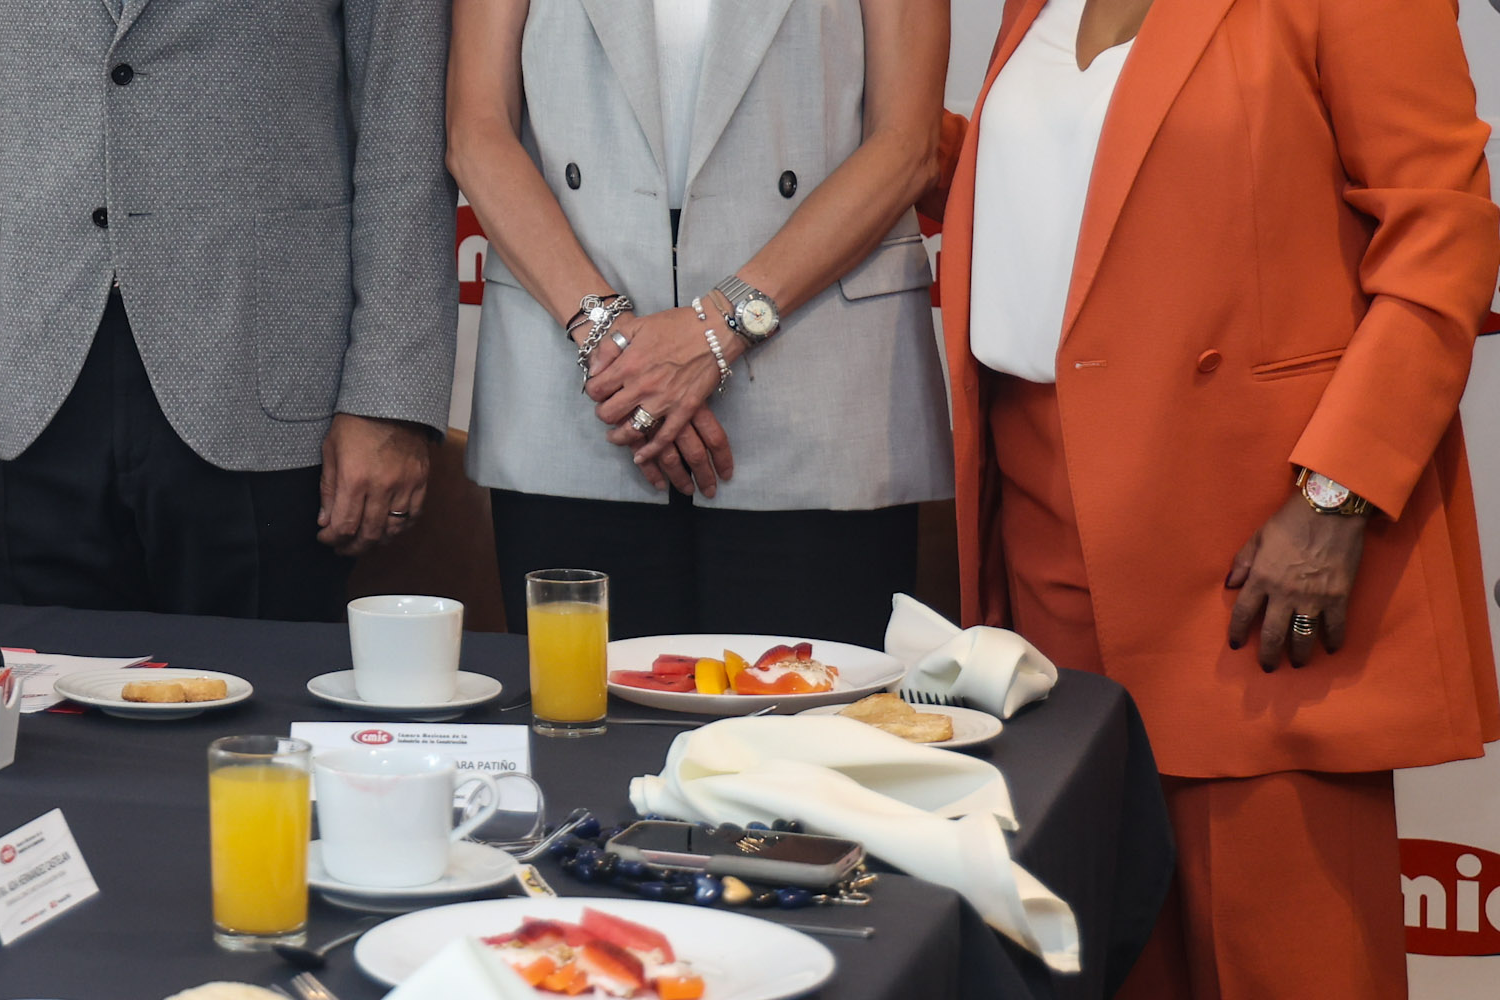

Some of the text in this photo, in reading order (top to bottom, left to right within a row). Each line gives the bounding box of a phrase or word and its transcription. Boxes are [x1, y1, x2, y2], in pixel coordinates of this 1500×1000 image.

[361, 730, 388, 742] cmic
[477, 759, 517, 771] PATIÑO
[1400, 853, 1500, 933] mi
